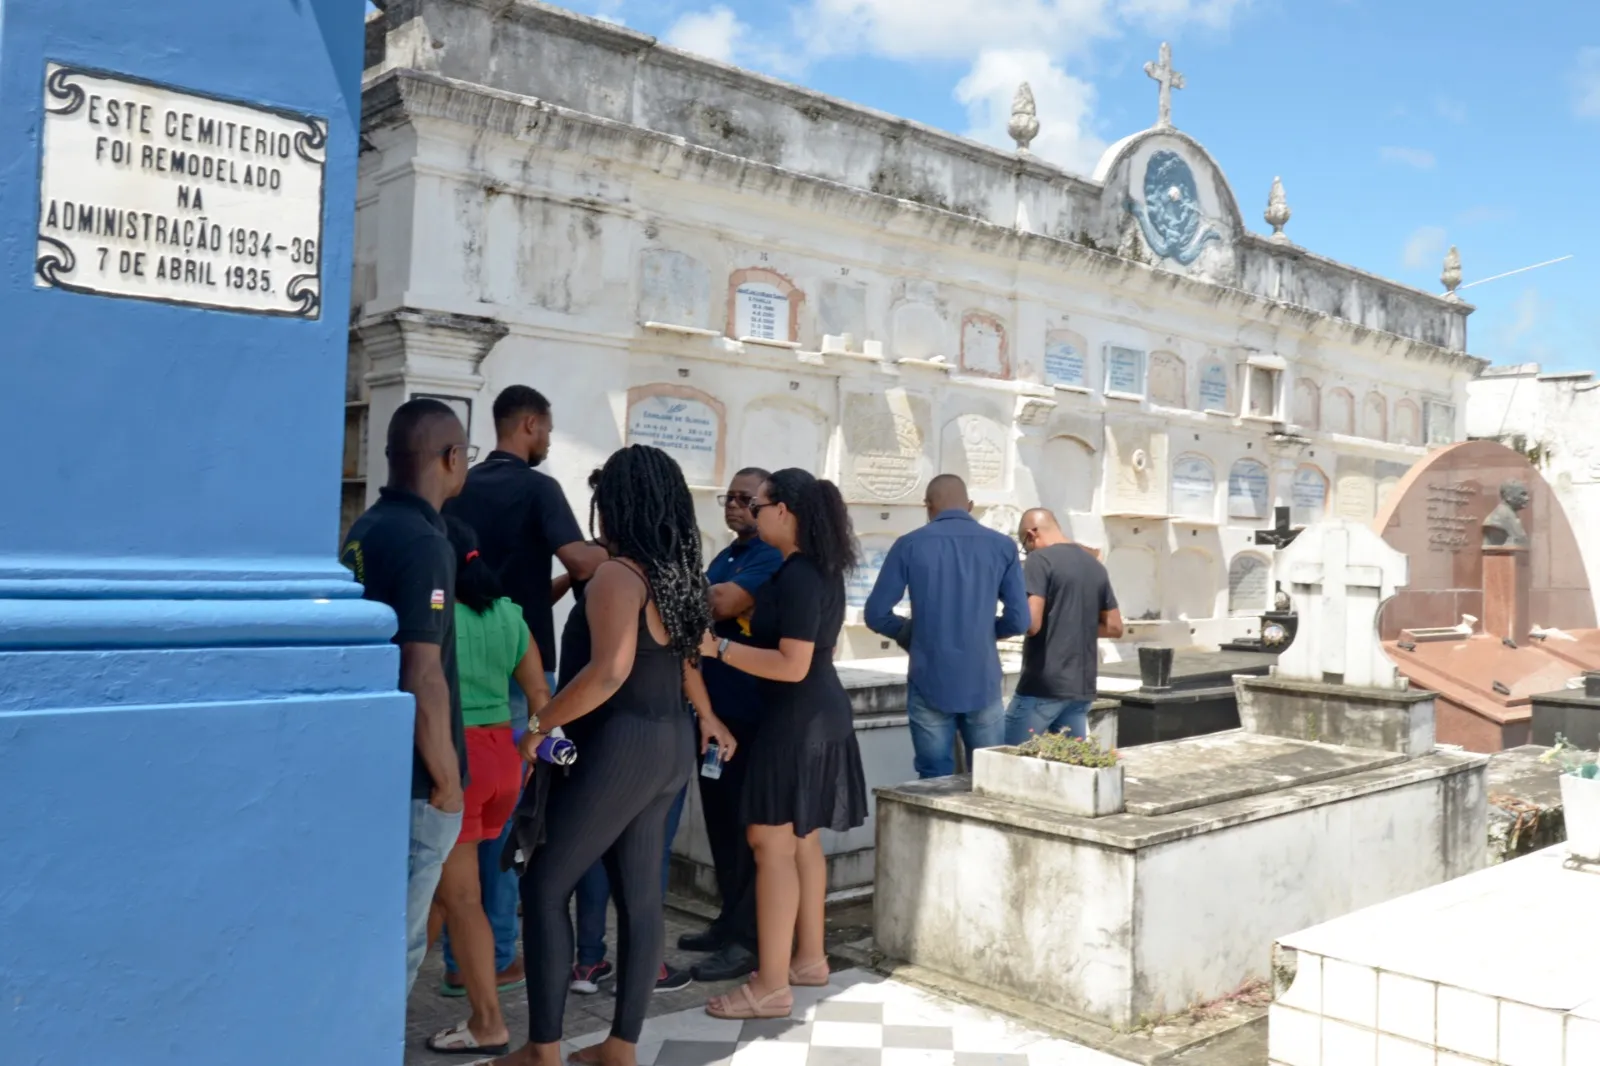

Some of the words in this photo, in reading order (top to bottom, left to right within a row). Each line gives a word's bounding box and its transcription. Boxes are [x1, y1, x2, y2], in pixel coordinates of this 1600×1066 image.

[88, 95, 152, 134] ESTE
[164, 110, 291, 159] CEMITERIO
[95, 136, 131, 166] FOI
[141, 145, 281, 191] REMODELADO
[177, 184, 203, 211] NA
[45, 199, 222, 254] ADMINISTRAÇÃO
[228, 229, 315, 265] 1934-36
[97, 247, 109, 271] 7
[119, 250, 146, 277] DE
[156, 255, 217, 286] ABRIL
